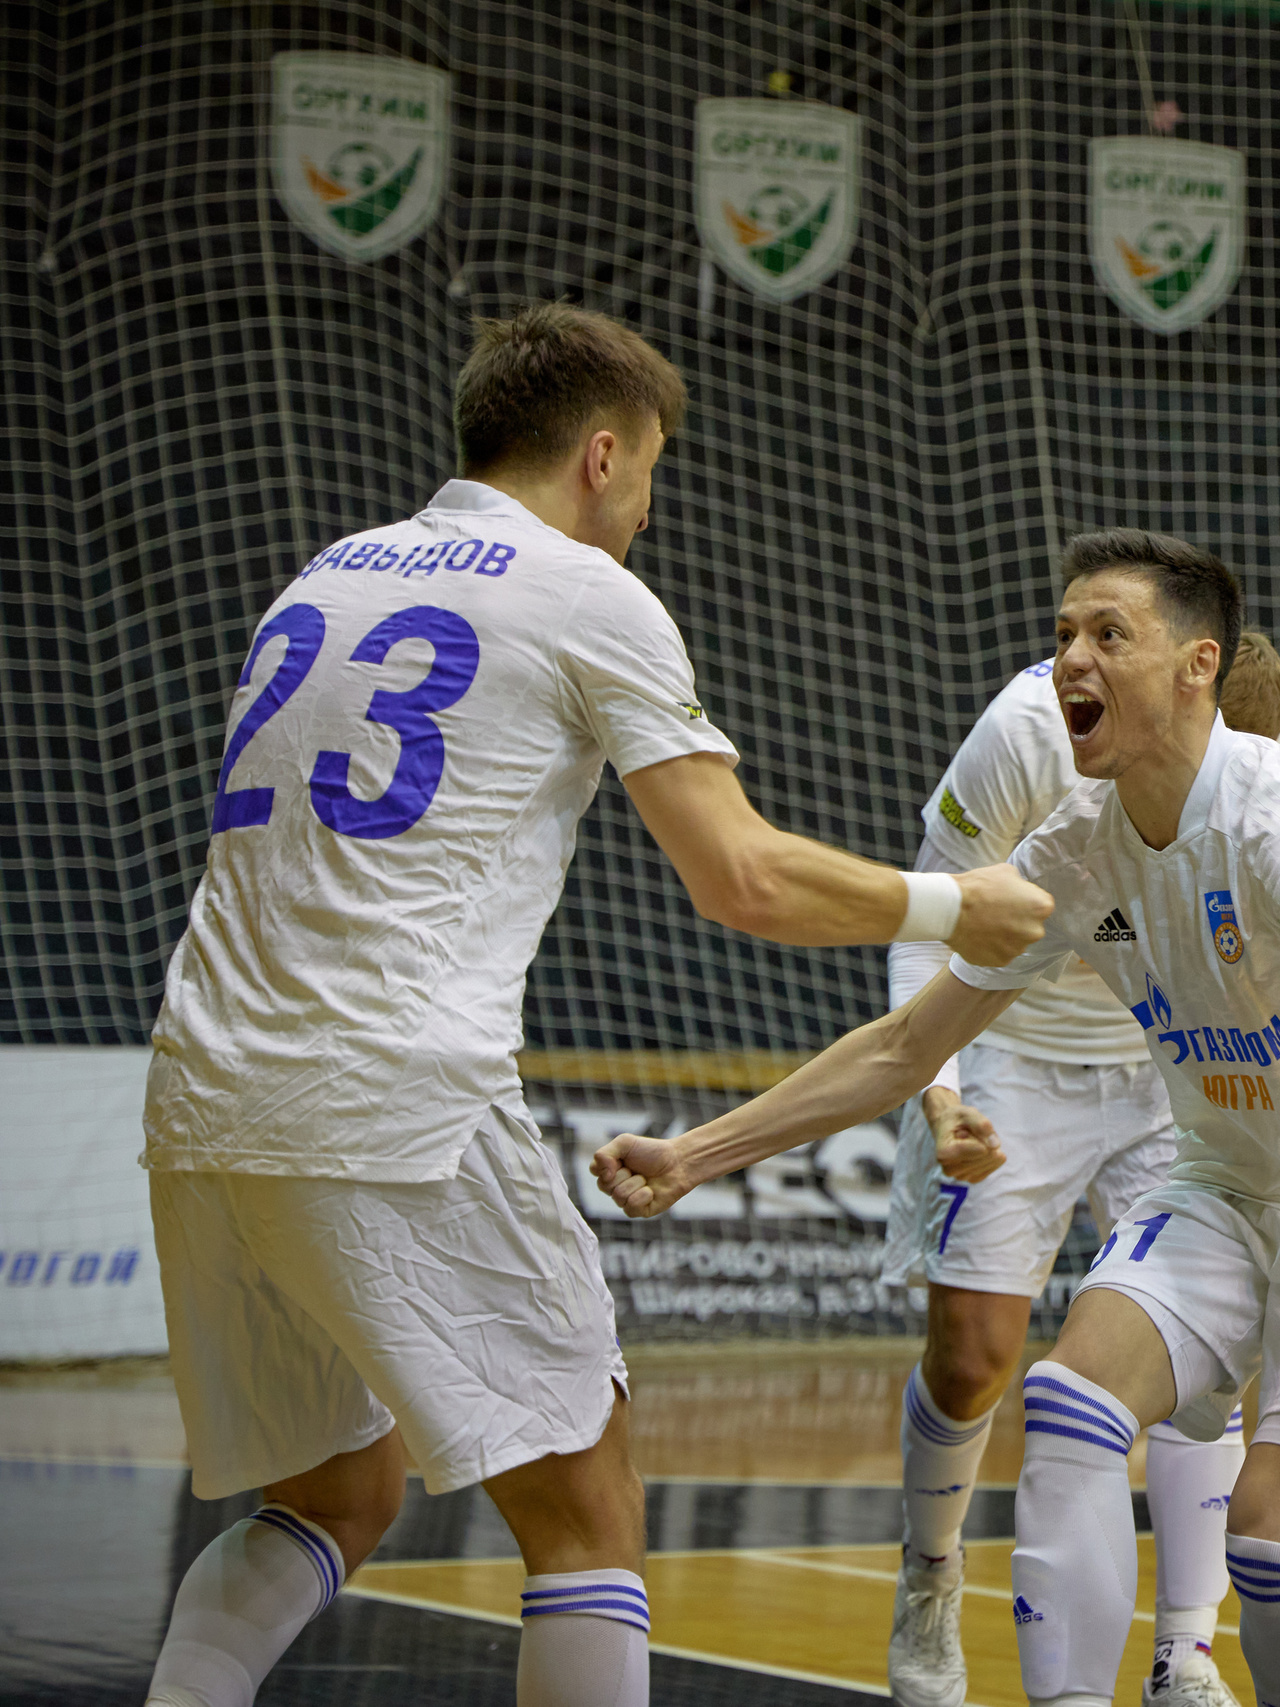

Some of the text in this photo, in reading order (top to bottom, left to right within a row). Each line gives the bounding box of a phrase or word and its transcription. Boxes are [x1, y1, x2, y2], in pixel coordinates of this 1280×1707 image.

[211, 602, 480, 840] 23
[1094, 929, 1137, 942] adidas
[1202, 1074, 1275, 1111] ЮГРА
[939, 1183, 969, 1255] 7
[0, 1246, 140, 1286] ОГОЙ
